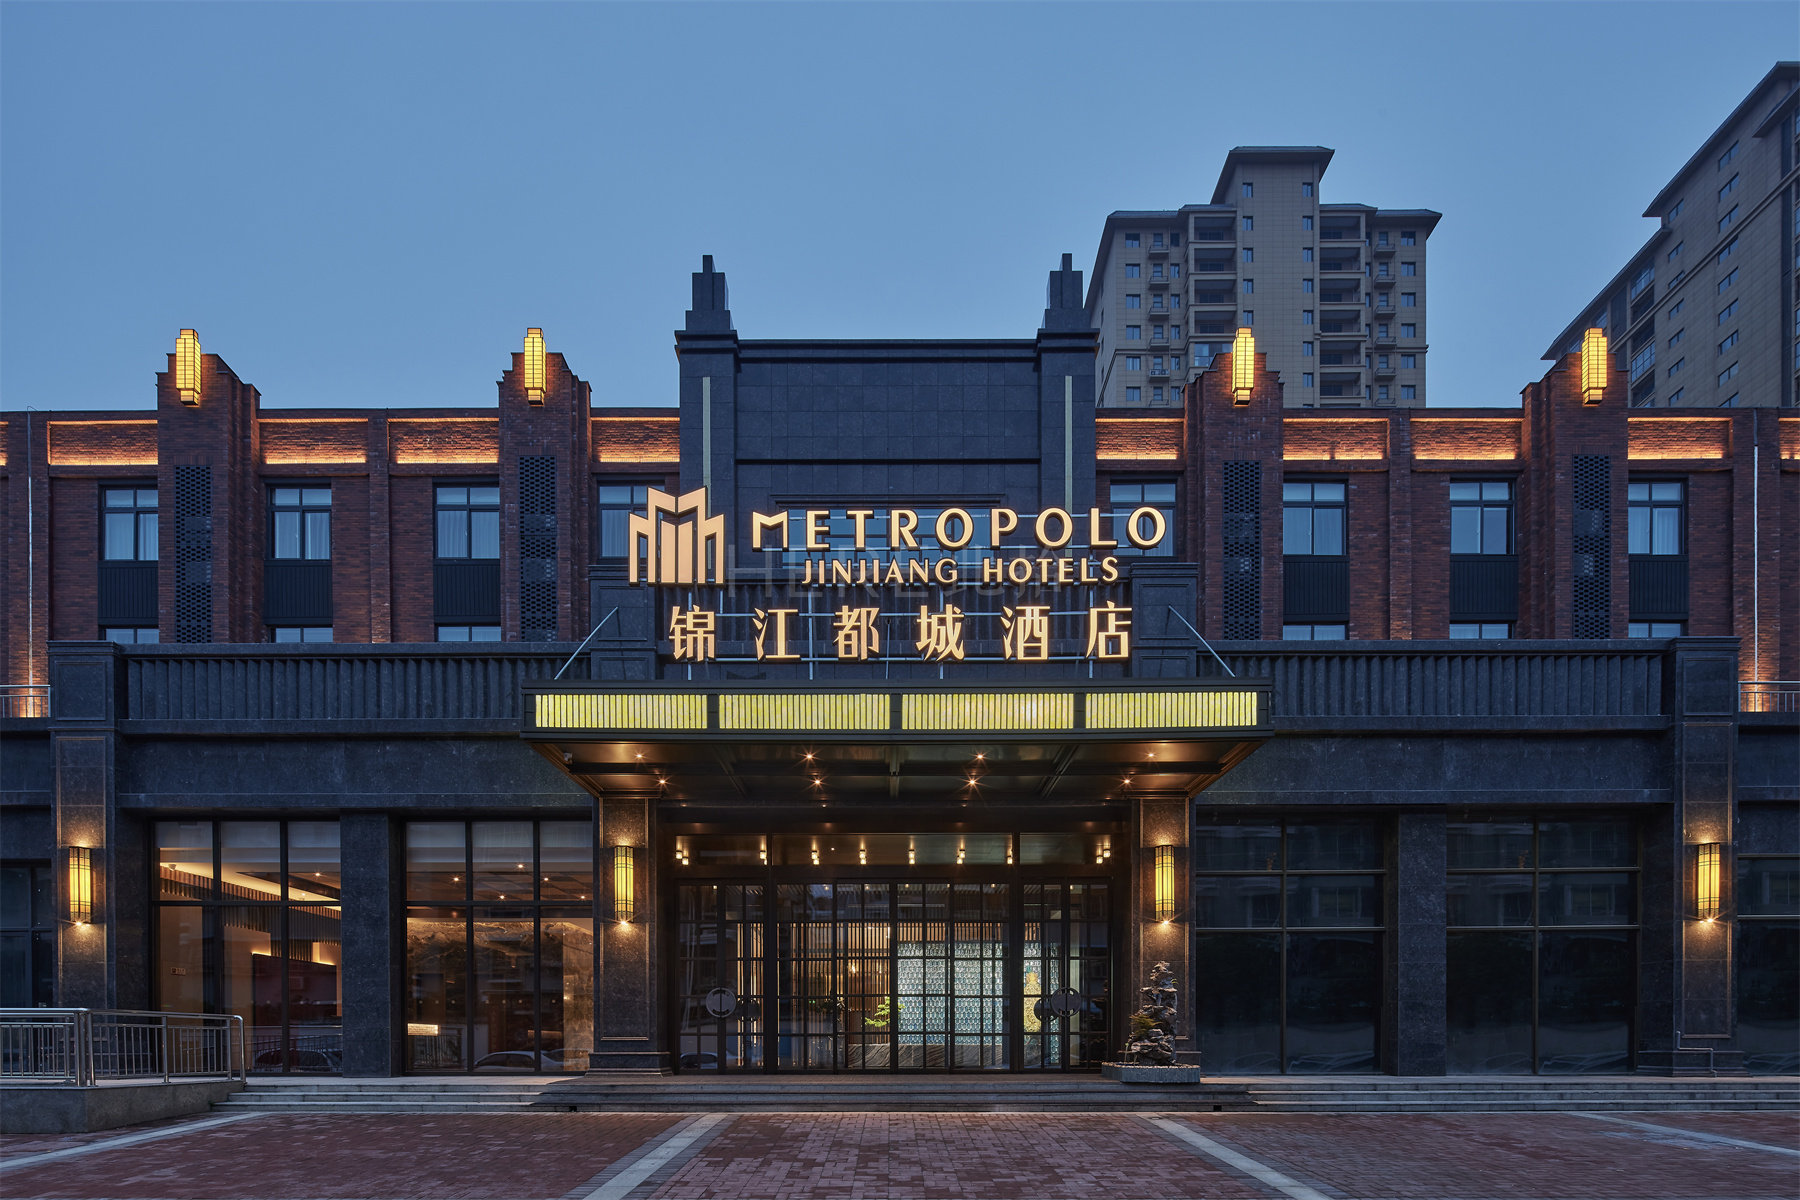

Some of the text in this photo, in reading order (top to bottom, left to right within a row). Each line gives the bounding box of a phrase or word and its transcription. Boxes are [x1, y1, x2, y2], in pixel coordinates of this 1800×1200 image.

[752, 505, 1167, 550] METROPOLO
[802, 556, 1119, 585] JINJIANG HOTELS
[669, 600, 1133, 662] 锦江都城酒店
